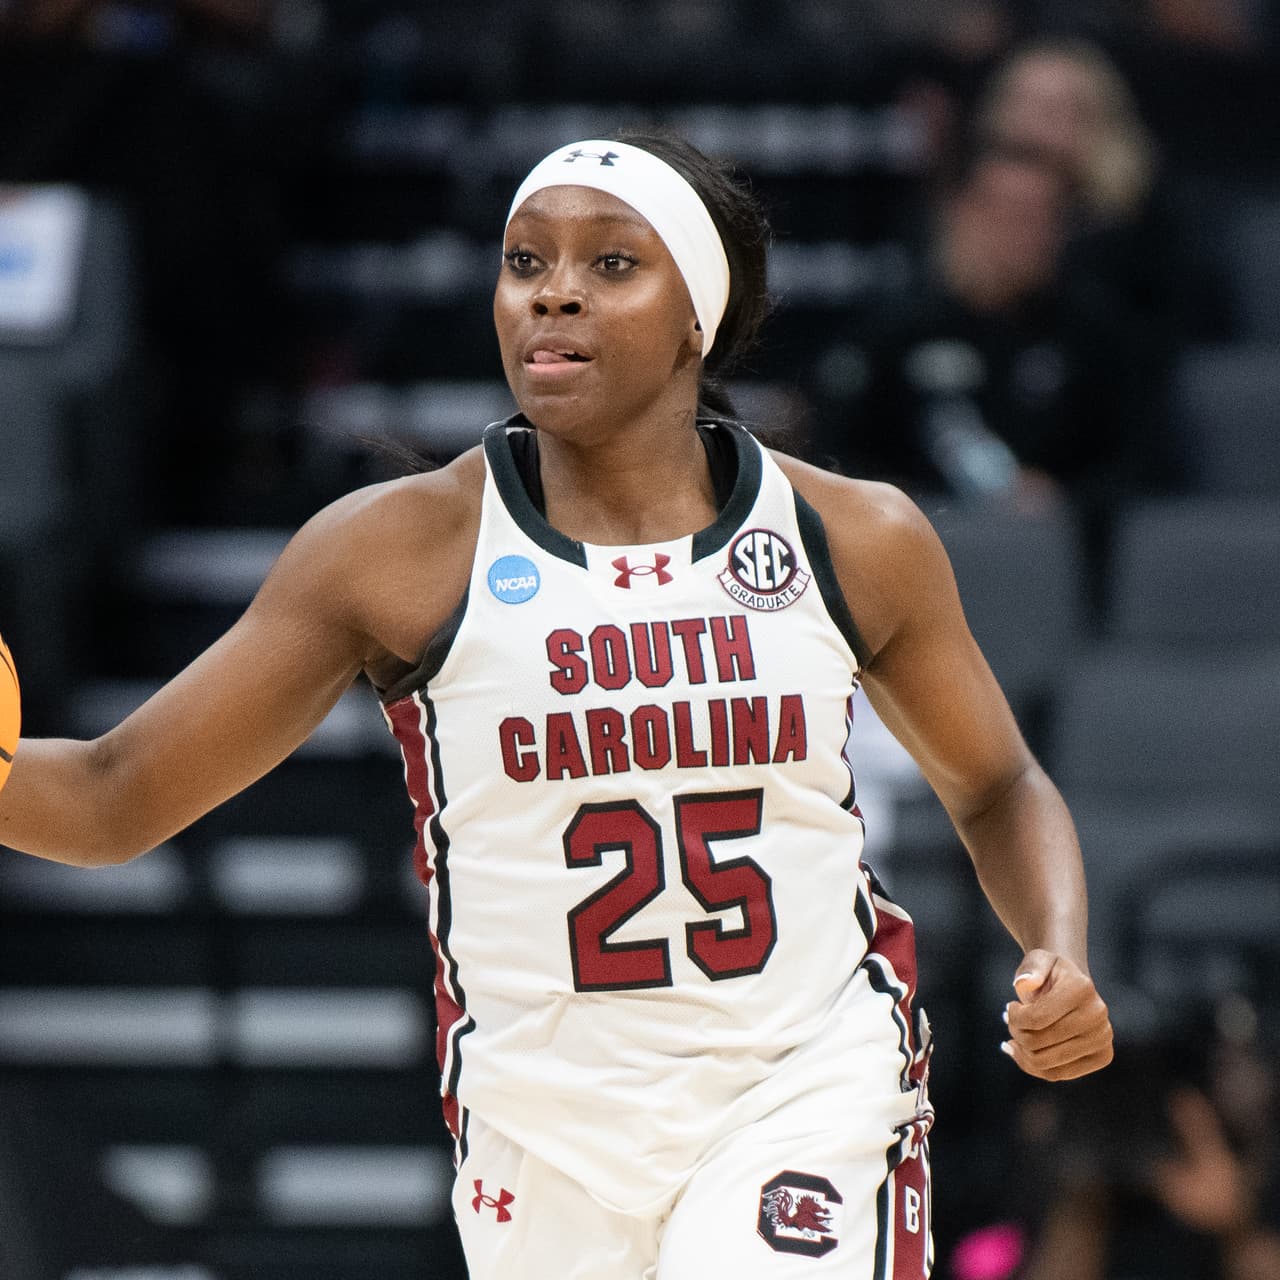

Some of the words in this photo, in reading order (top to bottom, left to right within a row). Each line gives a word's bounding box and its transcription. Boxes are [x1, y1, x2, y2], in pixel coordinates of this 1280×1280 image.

[494, 576, 538, 593] NCAA
[734, 531, 791, 591] SEC
[730, 584, 801, 610] GRADUATE
[545, 615, 756, 695] SOUTH
[498, 694, 808, 783] CAROLINA
[562, 787, 778, 993] 25
